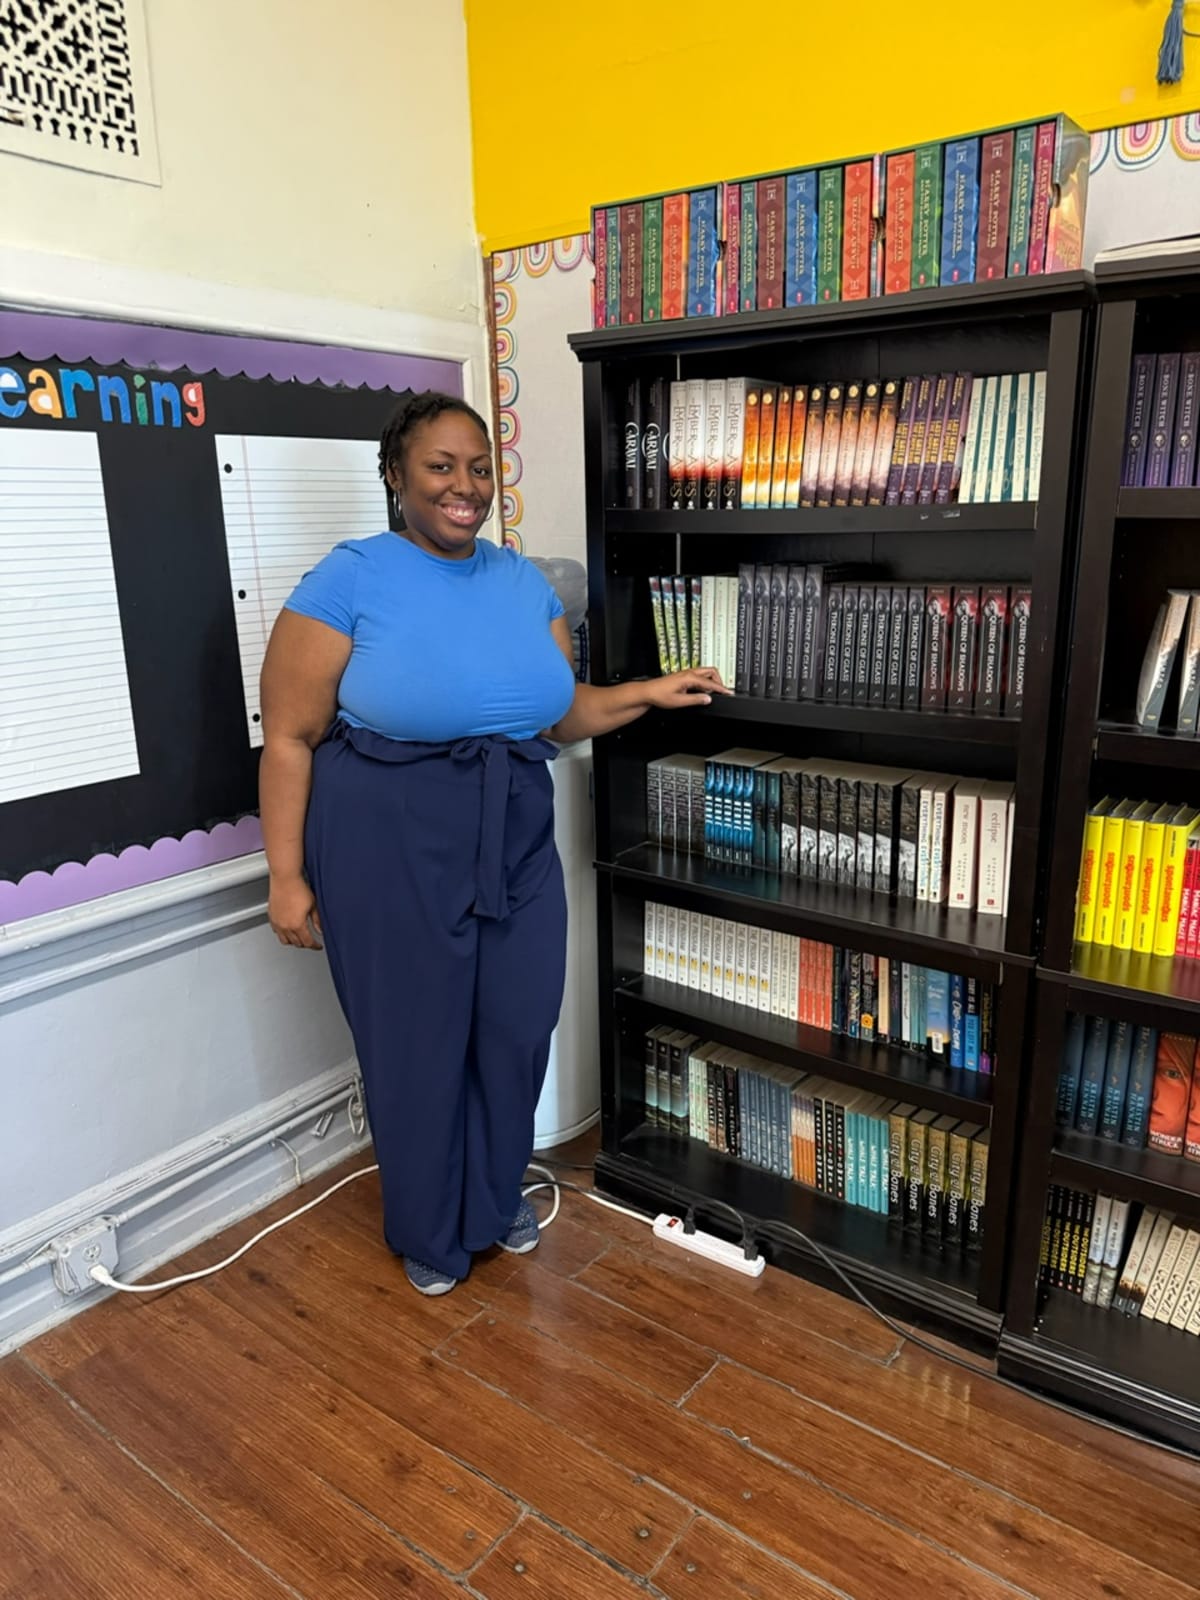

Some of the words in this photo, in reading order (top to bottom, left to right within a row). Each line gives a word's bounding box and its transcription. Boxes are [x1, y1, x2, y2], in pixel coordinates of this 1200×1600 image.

[0, 367, 206, 428] earning
[829, 612, 838, 644] THRONE
[845, 613, 853, 645] THRONE
[861, 613, 869, 646] THRONE
[877, 614, 885, 647] THRONE
[893, 614, 902, 648] THRONE
[911, 615, 919, 649] THRONE
[932, 615, 940, 640] QUEEN
[960, 615, 969, 641] QUEEN
[988, 616, 997, 642] QUEEN
[1019, 616, 1028, 643] QUEEN
[828, 645, 836, 655] OF
[843, 647, 852, 657] OF
[859, 648, 867, 658] OF
[875, 649, 883, 659] OF
[892, 649, 900, 660] OF
[910, 650, 918, 661] OF
[931, 641, 939, 652] OF
[959, 642, 968, 653] OF
[987, 643, 996, 653] OF
[1017, 644, 1026, 655] OF
[826, 657, 835, 680] GLASS
[842, 659, 851, 681] GLASS
[857, 660, 866, 683] GLASS
[873, 661, 882, 684] GLASS
[890, 661, 898, 685] GLASS
[908, 662, 917, 686] GLASS
[930, 653, 938, 689] SHADOWS
[958, 654, 966, 691] SHADOWS
[986, 655, 994, 692] SHADOWS
[1016, 656, 1025, 695] SHADOWS
[987, 812, 1001, 843] eclipse
[888, 1132, 901, 1156] City
[908, 1139, 921, 1163] City
[928, 1146, 943, 1170] City
[949, 1153, 964, 1176] City
[970, 1160, 984, 1184] City
[890, 1170, 902, 1204] Bones
[909, 1177, 921, 1211] Bones
[928, 1184, 941, 1218] Bones
[948, 1191, 962, 1225] Bones
[969, 1199, 984, 1233] Bones
[1039, 1226, 1051, 1266] OUTSIDERS
[1050, 1229, 1061, 1269] OUTSIDERS
[1059, 1232, 1070, 1272] OUTSIDERS
[1068, 1235, 1080, 1275] OUTSIDERS
[1077, 1238, 1089, 1278] OUTSIDERS
